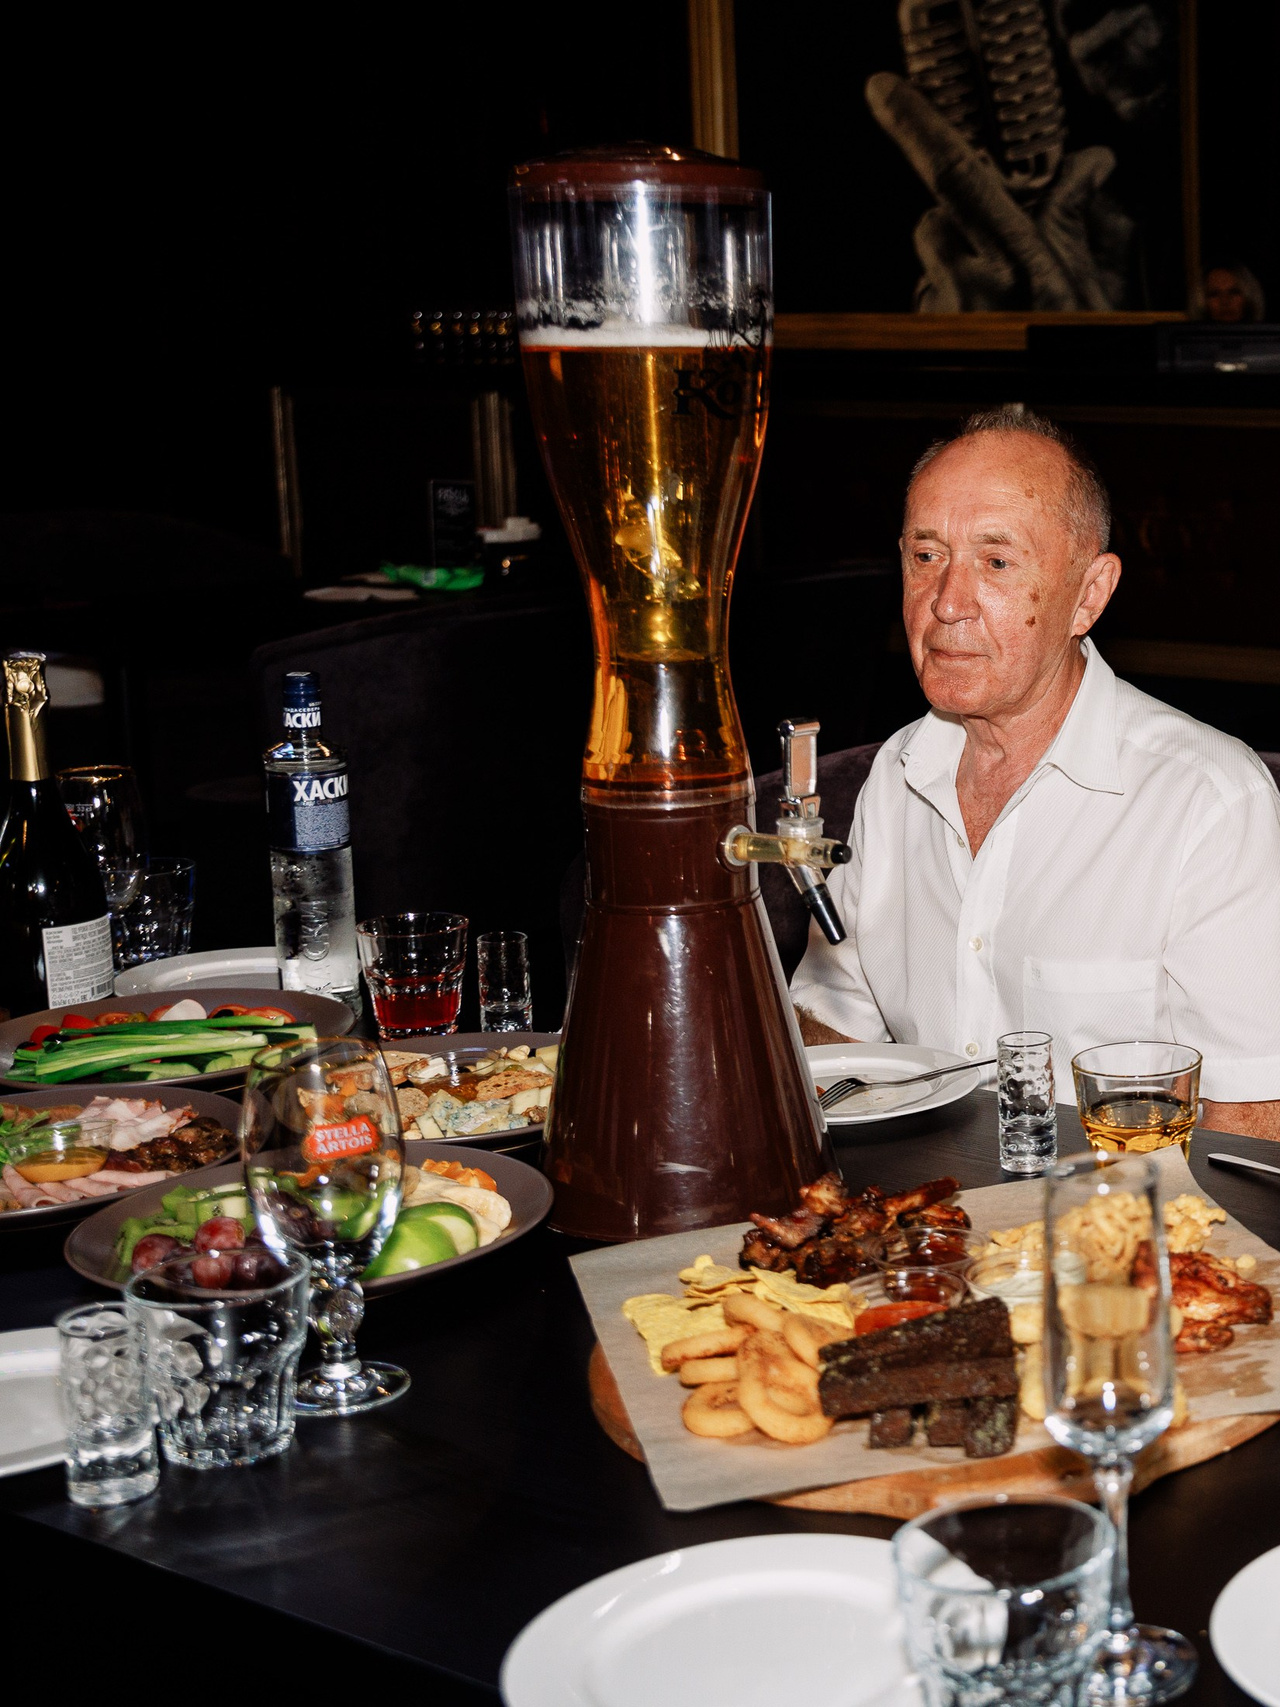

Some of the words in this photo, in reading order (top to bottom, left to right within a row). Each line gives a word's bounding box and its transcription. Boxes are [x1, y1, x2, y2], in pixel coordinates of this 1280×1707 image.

[283, 711, 321, 728] АСКИ
[314, 1122, 371, 1142] STELLA
[316, 1134, 373, 1155] ARTOIS
